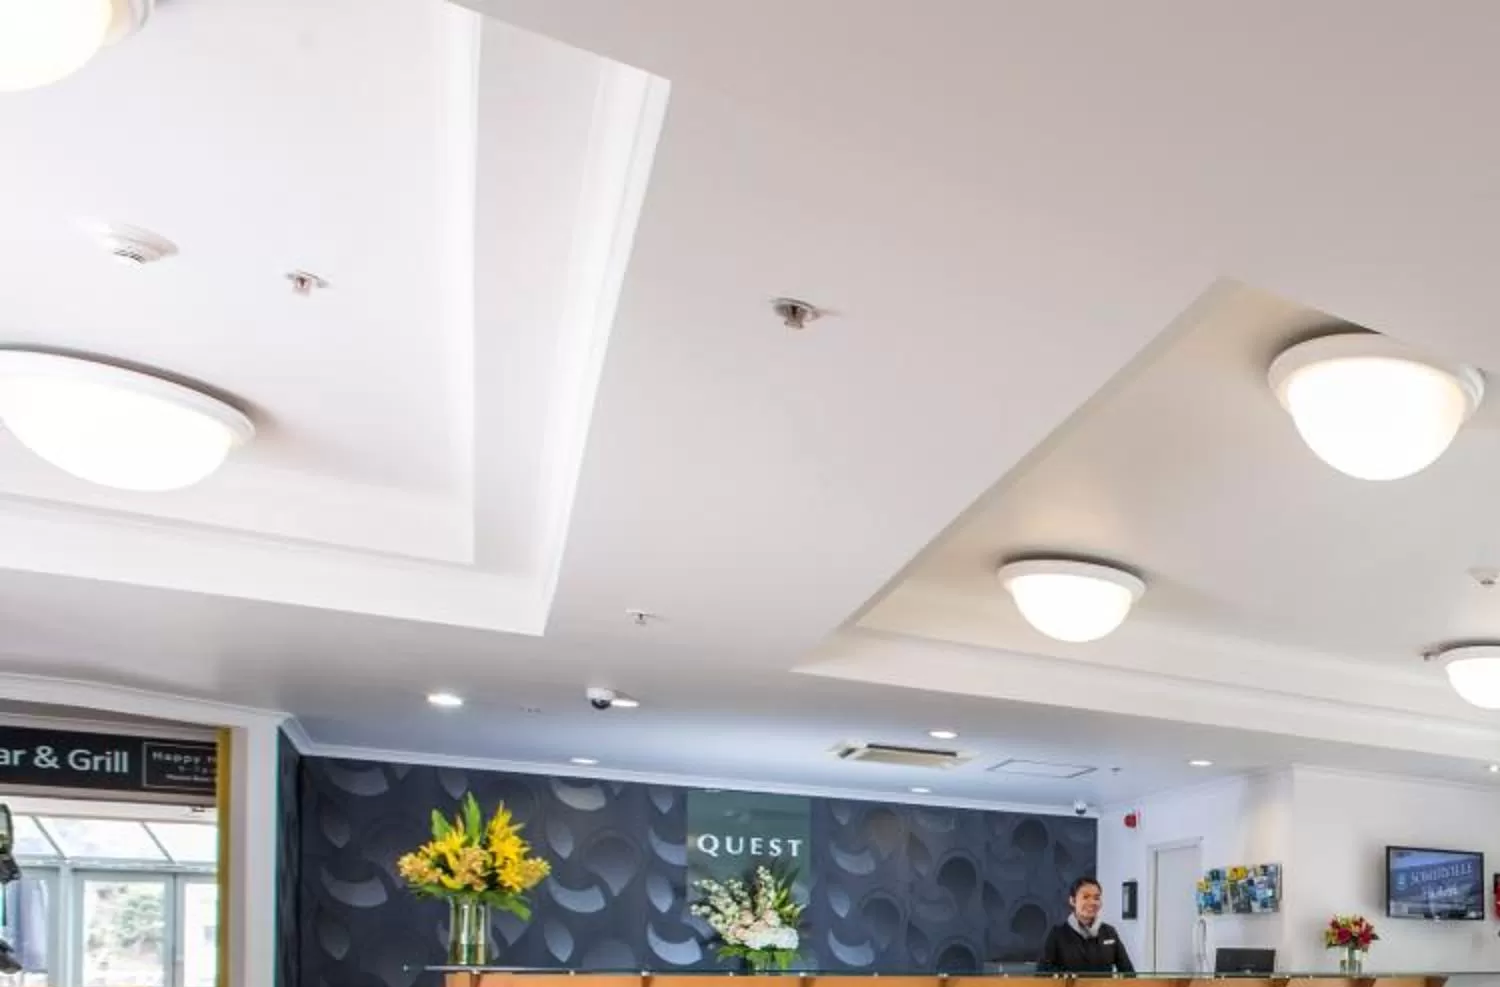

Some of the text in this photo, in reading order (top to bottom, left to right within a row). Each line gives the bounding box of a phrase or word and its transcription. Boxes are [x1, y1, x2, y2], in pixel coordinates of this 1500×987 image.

[33, 745, 60, 770] &
[67, 749, 129, 774] Grill
[697, 833, 803, 858] QUEST
